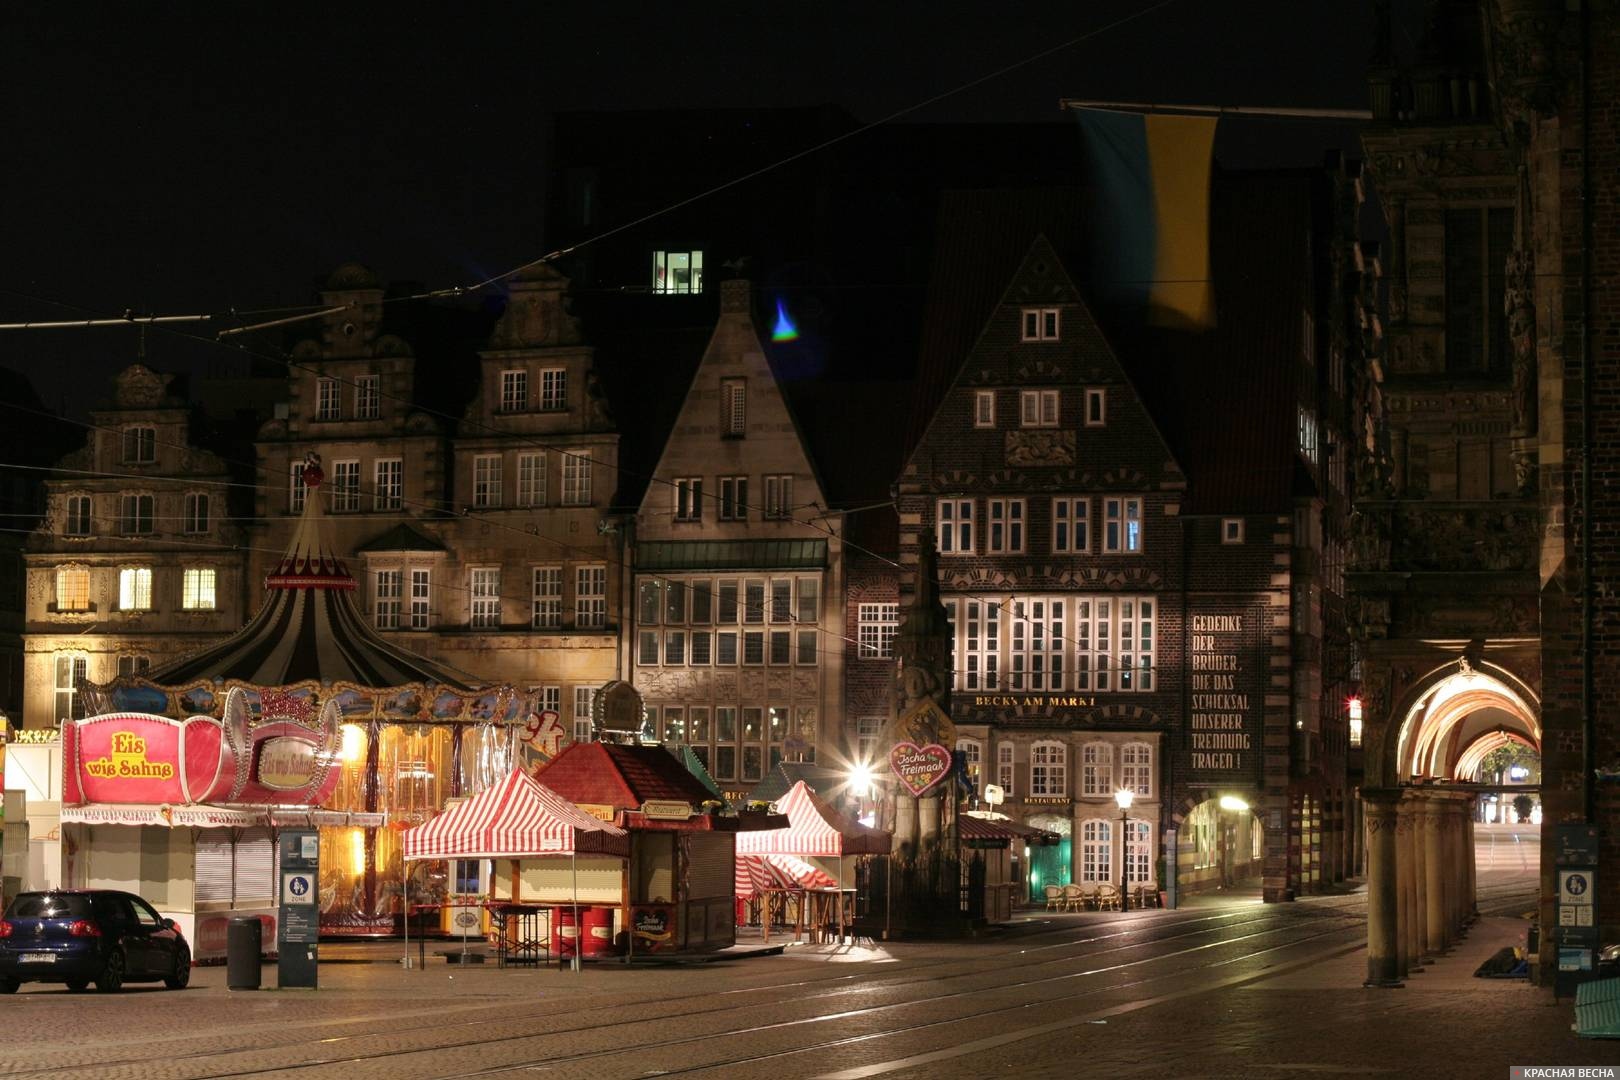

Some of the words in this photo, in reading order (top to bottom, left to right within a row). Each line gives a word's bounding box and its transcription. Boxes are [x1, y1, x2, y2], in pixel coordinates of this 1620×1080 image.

[1193, 615, 1242, 631] GEDENKE
[1193, 635, 1215, 651] DER
[1193, 674, 1210, 690] DIE
[1214, 674, 1234, 690] DAS
[1023, 696, 1043, 706] AM
[1192, 694, 1250, 709] SCHICKSAL
[1192, 714, 1242, 729] UNSERER
[113, 733, 146, 754] Eis
[1191, 733, 1250, 750] TRENNUNG
[119, 758, 173, 778] Sahne
[900, 759, 944, 776] Freimaak
